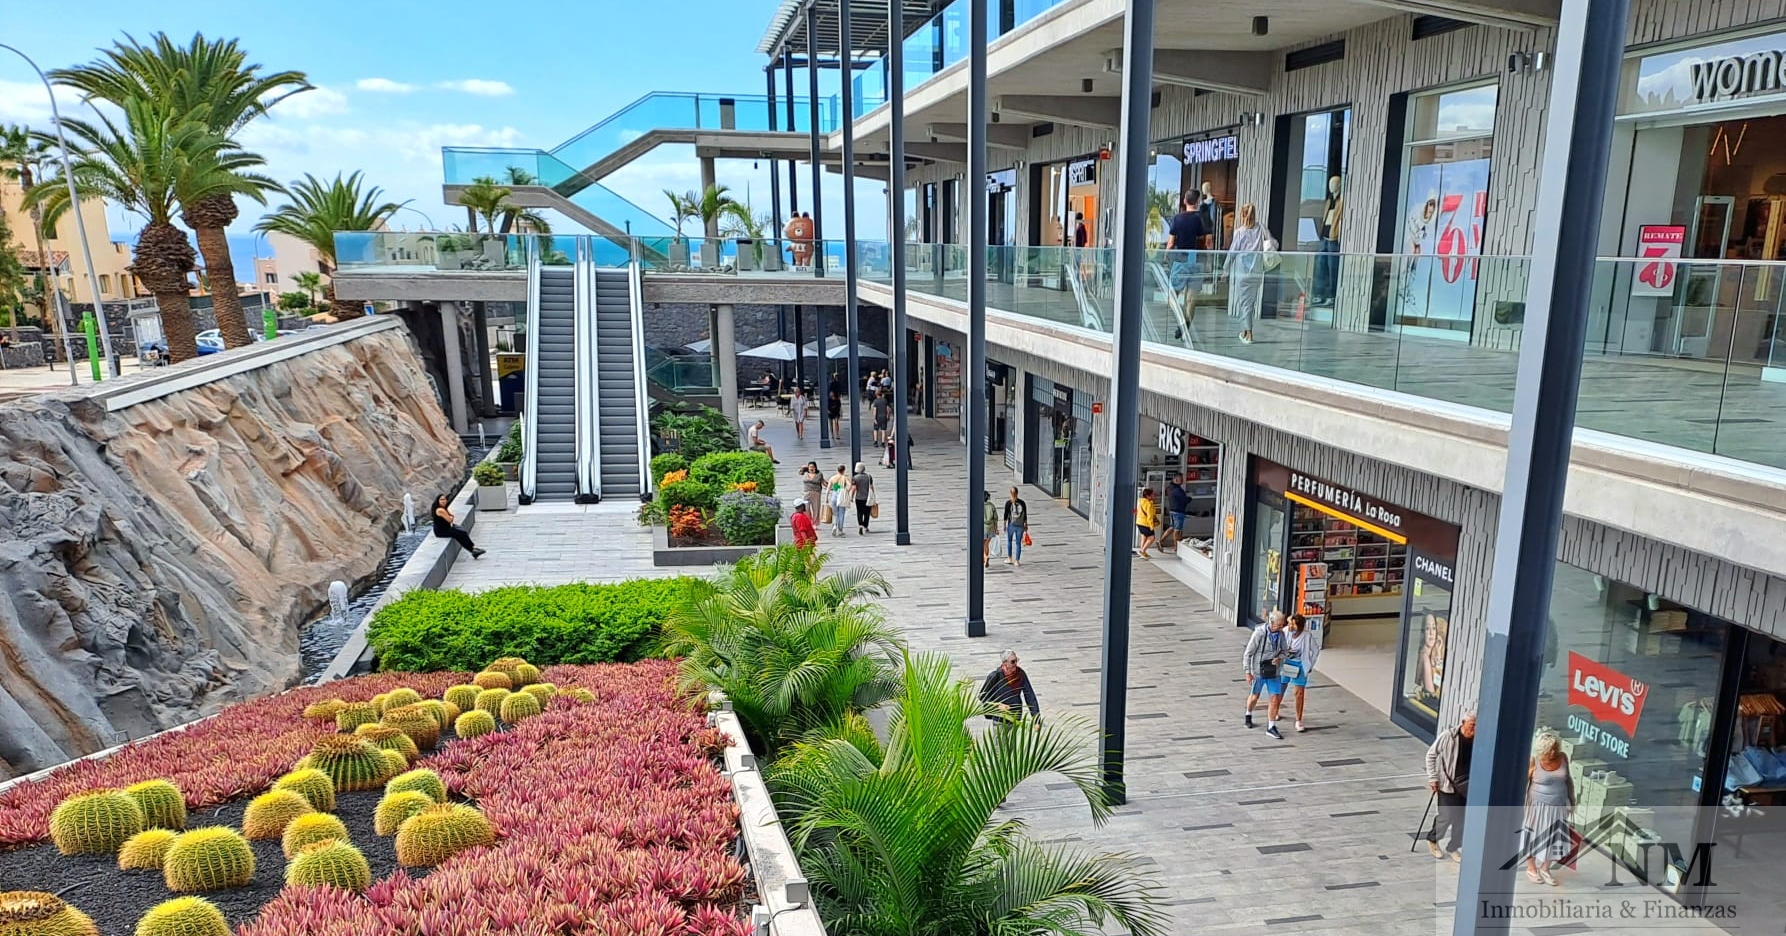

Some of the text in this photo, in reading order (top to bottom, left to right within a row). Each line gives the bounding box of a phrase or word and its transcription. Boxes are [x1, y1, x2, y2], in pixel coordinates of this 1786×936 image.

[1643, 232, 1683, 240] REMATE
[1158, 422, 1182, 455] RKS
[1291, 473, 1401, 527] PERFUMERÍA La Rosa
[1415, 556, 1454, 583] CHANEL
[1567, 714, 1630, 758] OUTLET STORE
